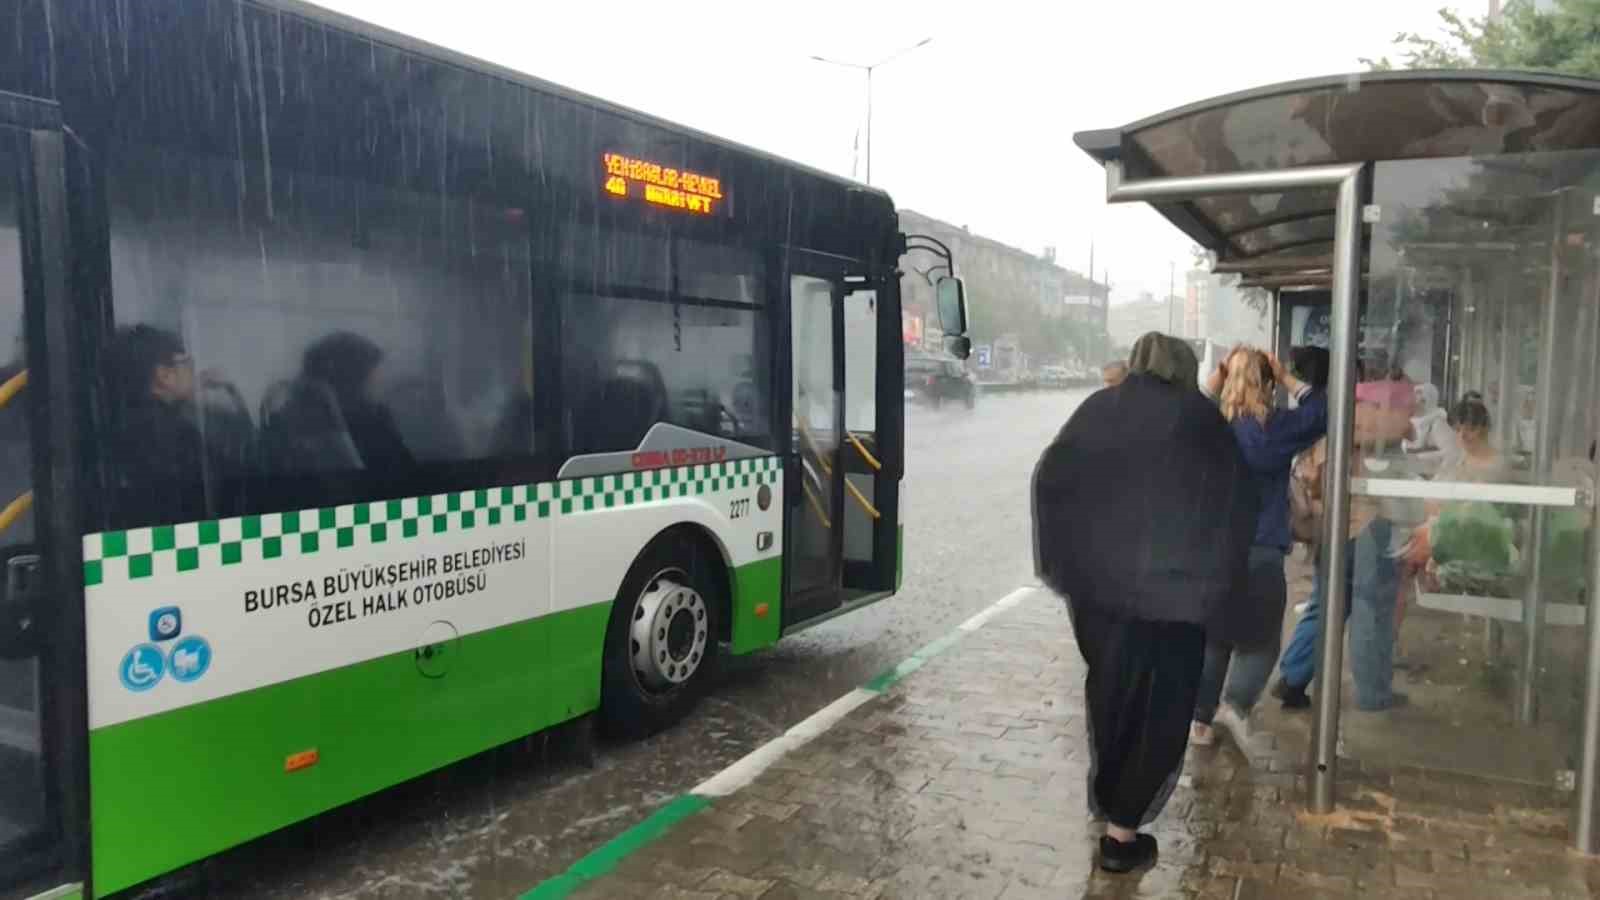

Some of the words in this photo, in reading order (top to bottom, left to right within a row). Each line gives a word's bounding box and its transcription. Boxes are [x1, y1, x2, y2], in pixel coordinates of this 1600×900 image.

[730, 498, 750, 520] 2277
[244, 580, 317, 612] BURSA
[324, 555, 437, 597] BÜYÜKŞEHİR
[443, 538, 526, 574] BELEDİYESİ
[308, 602, 357, 629] ÖZEL
[363, 588, 408, 617] HALK
[414, 570, 487, 605] OTOBÜSÜ
